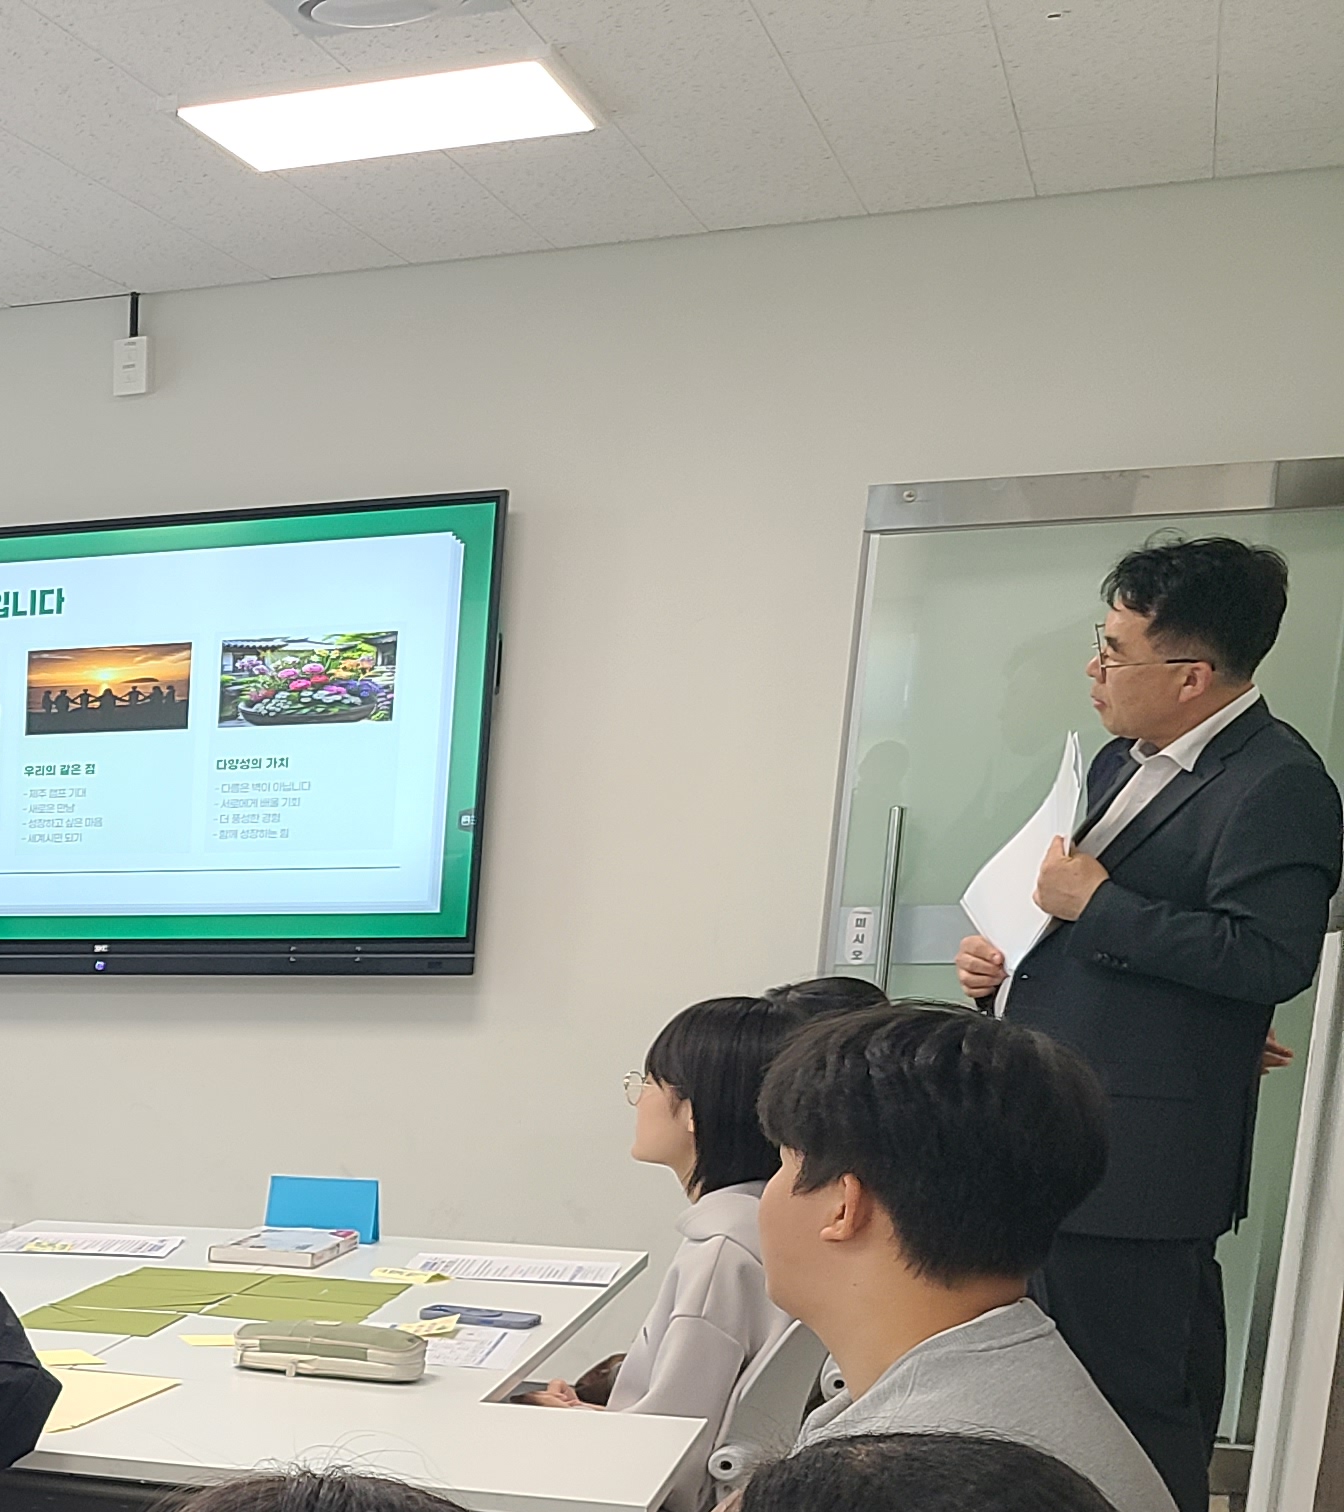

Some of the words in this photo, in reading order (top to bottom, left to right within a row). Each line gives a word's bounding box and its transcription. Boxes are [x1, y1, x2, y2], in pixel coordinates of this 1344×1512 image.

[216, 758, 262, 770] 다양성의
[265, 757, 289, 769] 가치
[23, 765, 56, 777] 우리의
[59, 764, 81, 776] 같은
[85, 763, 96, 775] 점
[273, 780, 312, 791] 아닙니다
[68, 787, 87, 798] 기대
[281, 797, 301, 807] 기회
[57, 803, 75, 813] 만남
[28, 818, 64, 829] 성장하고
[85, 817, 103, 828] 마음
[219, 814, 229, 824] 더
[64, 832, 83, 843] 되기
[851, 917, 866, 960] 미시오
